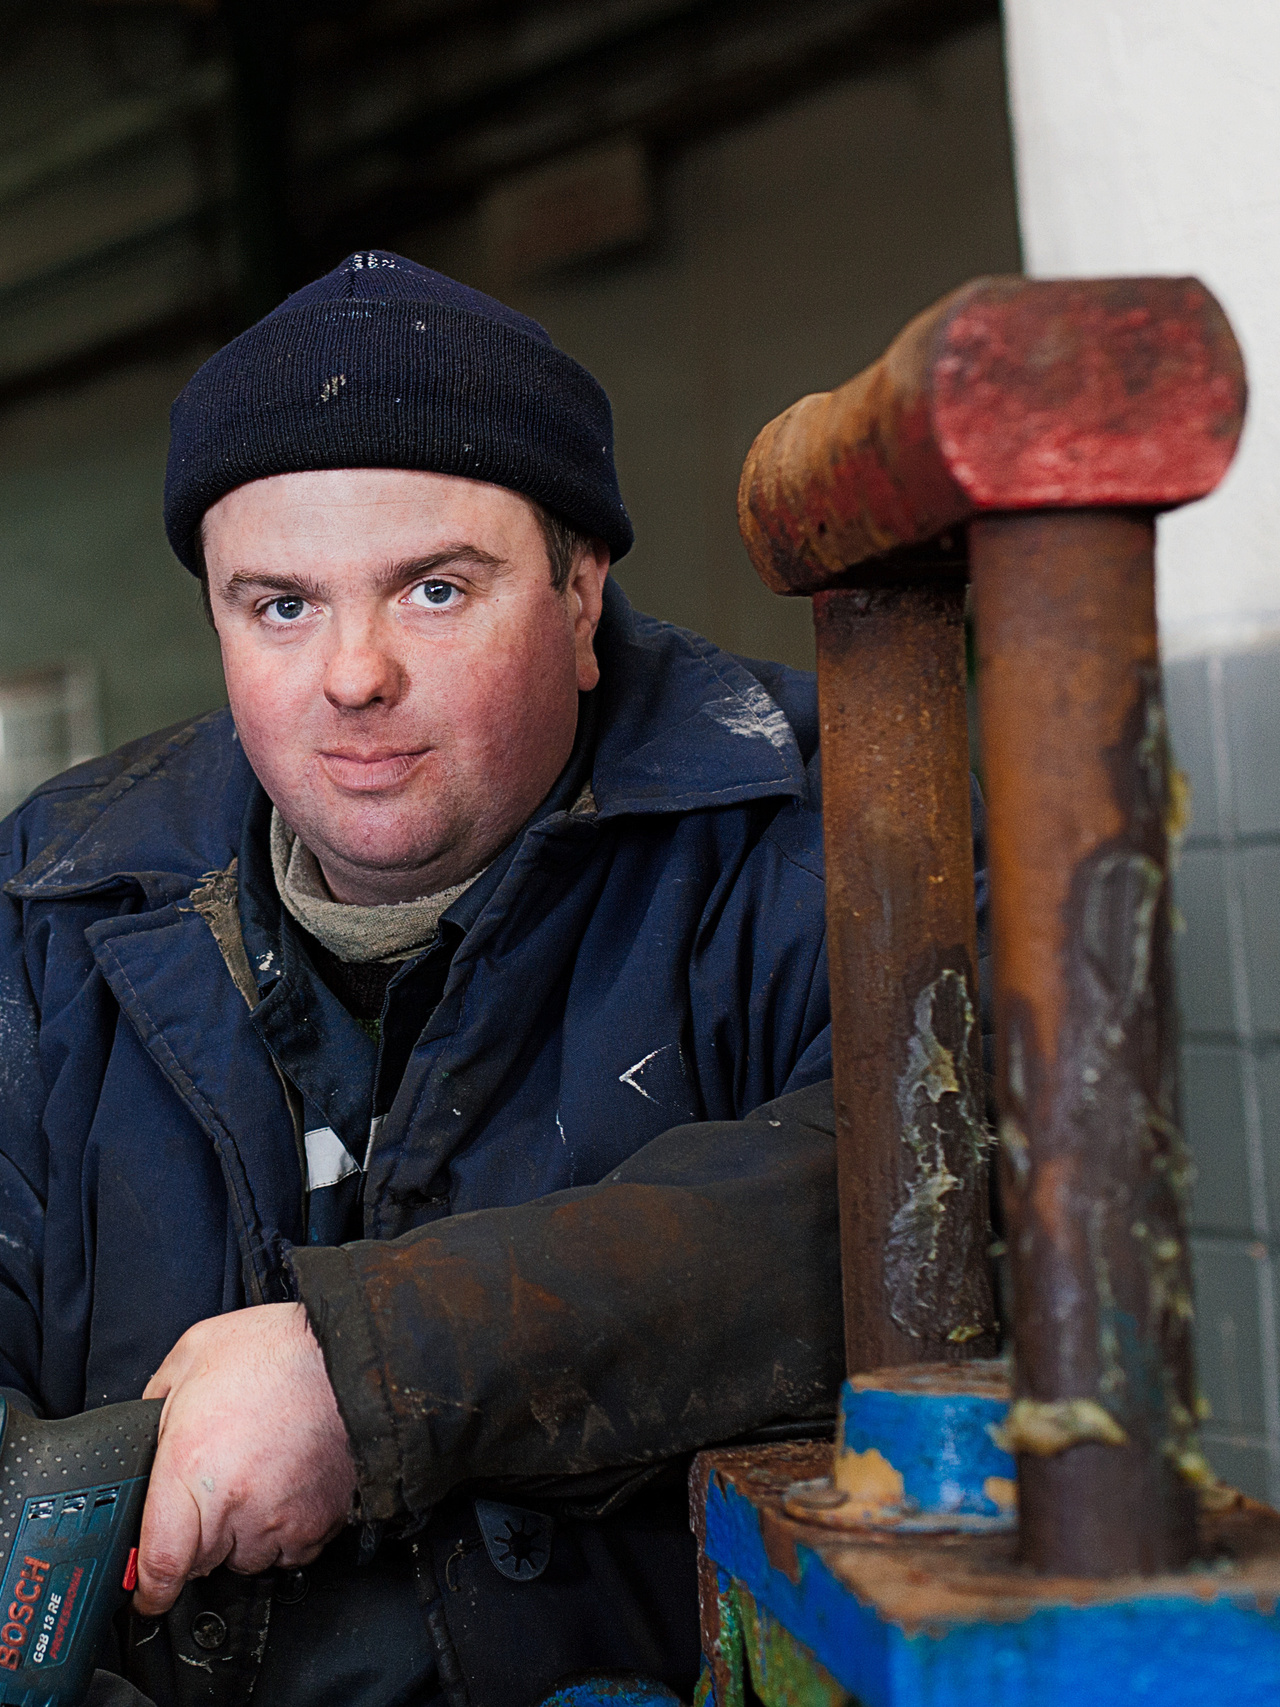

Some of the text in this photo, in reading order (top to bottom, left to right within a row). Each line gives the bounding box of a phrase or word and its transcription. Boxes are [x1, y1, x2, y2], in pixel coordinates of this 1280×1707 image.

[33, 1593, 62, 1663] GSB 13 RE
[49, 1566, 84, 1660] PROFESSIONAL
